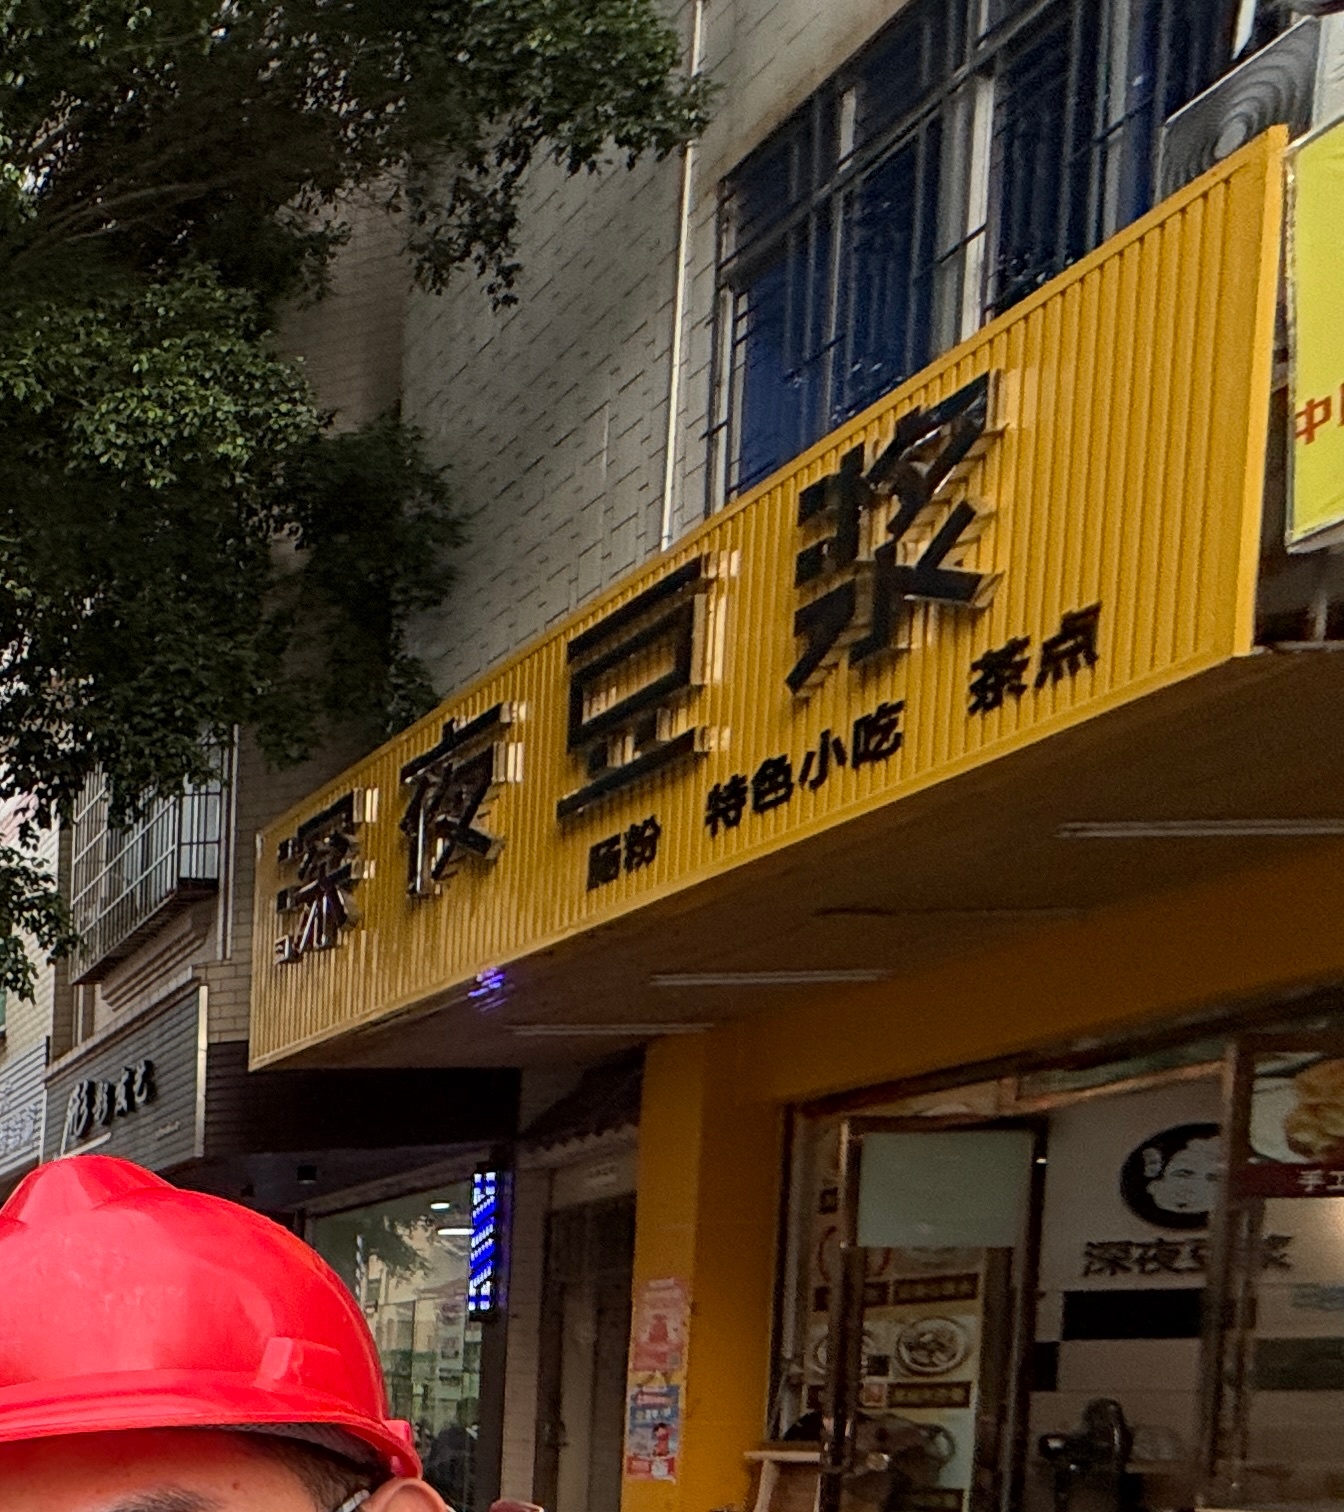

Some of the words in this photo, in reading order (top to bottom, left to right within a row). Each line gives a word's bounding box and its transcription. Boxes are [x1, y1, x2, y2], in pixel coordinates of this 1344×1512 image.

[274, 370, 1002, 966] 深夜豆浆
[705, 700, 906, 838] 特色小吃
[967, 600, 1104, 715] 茶点
